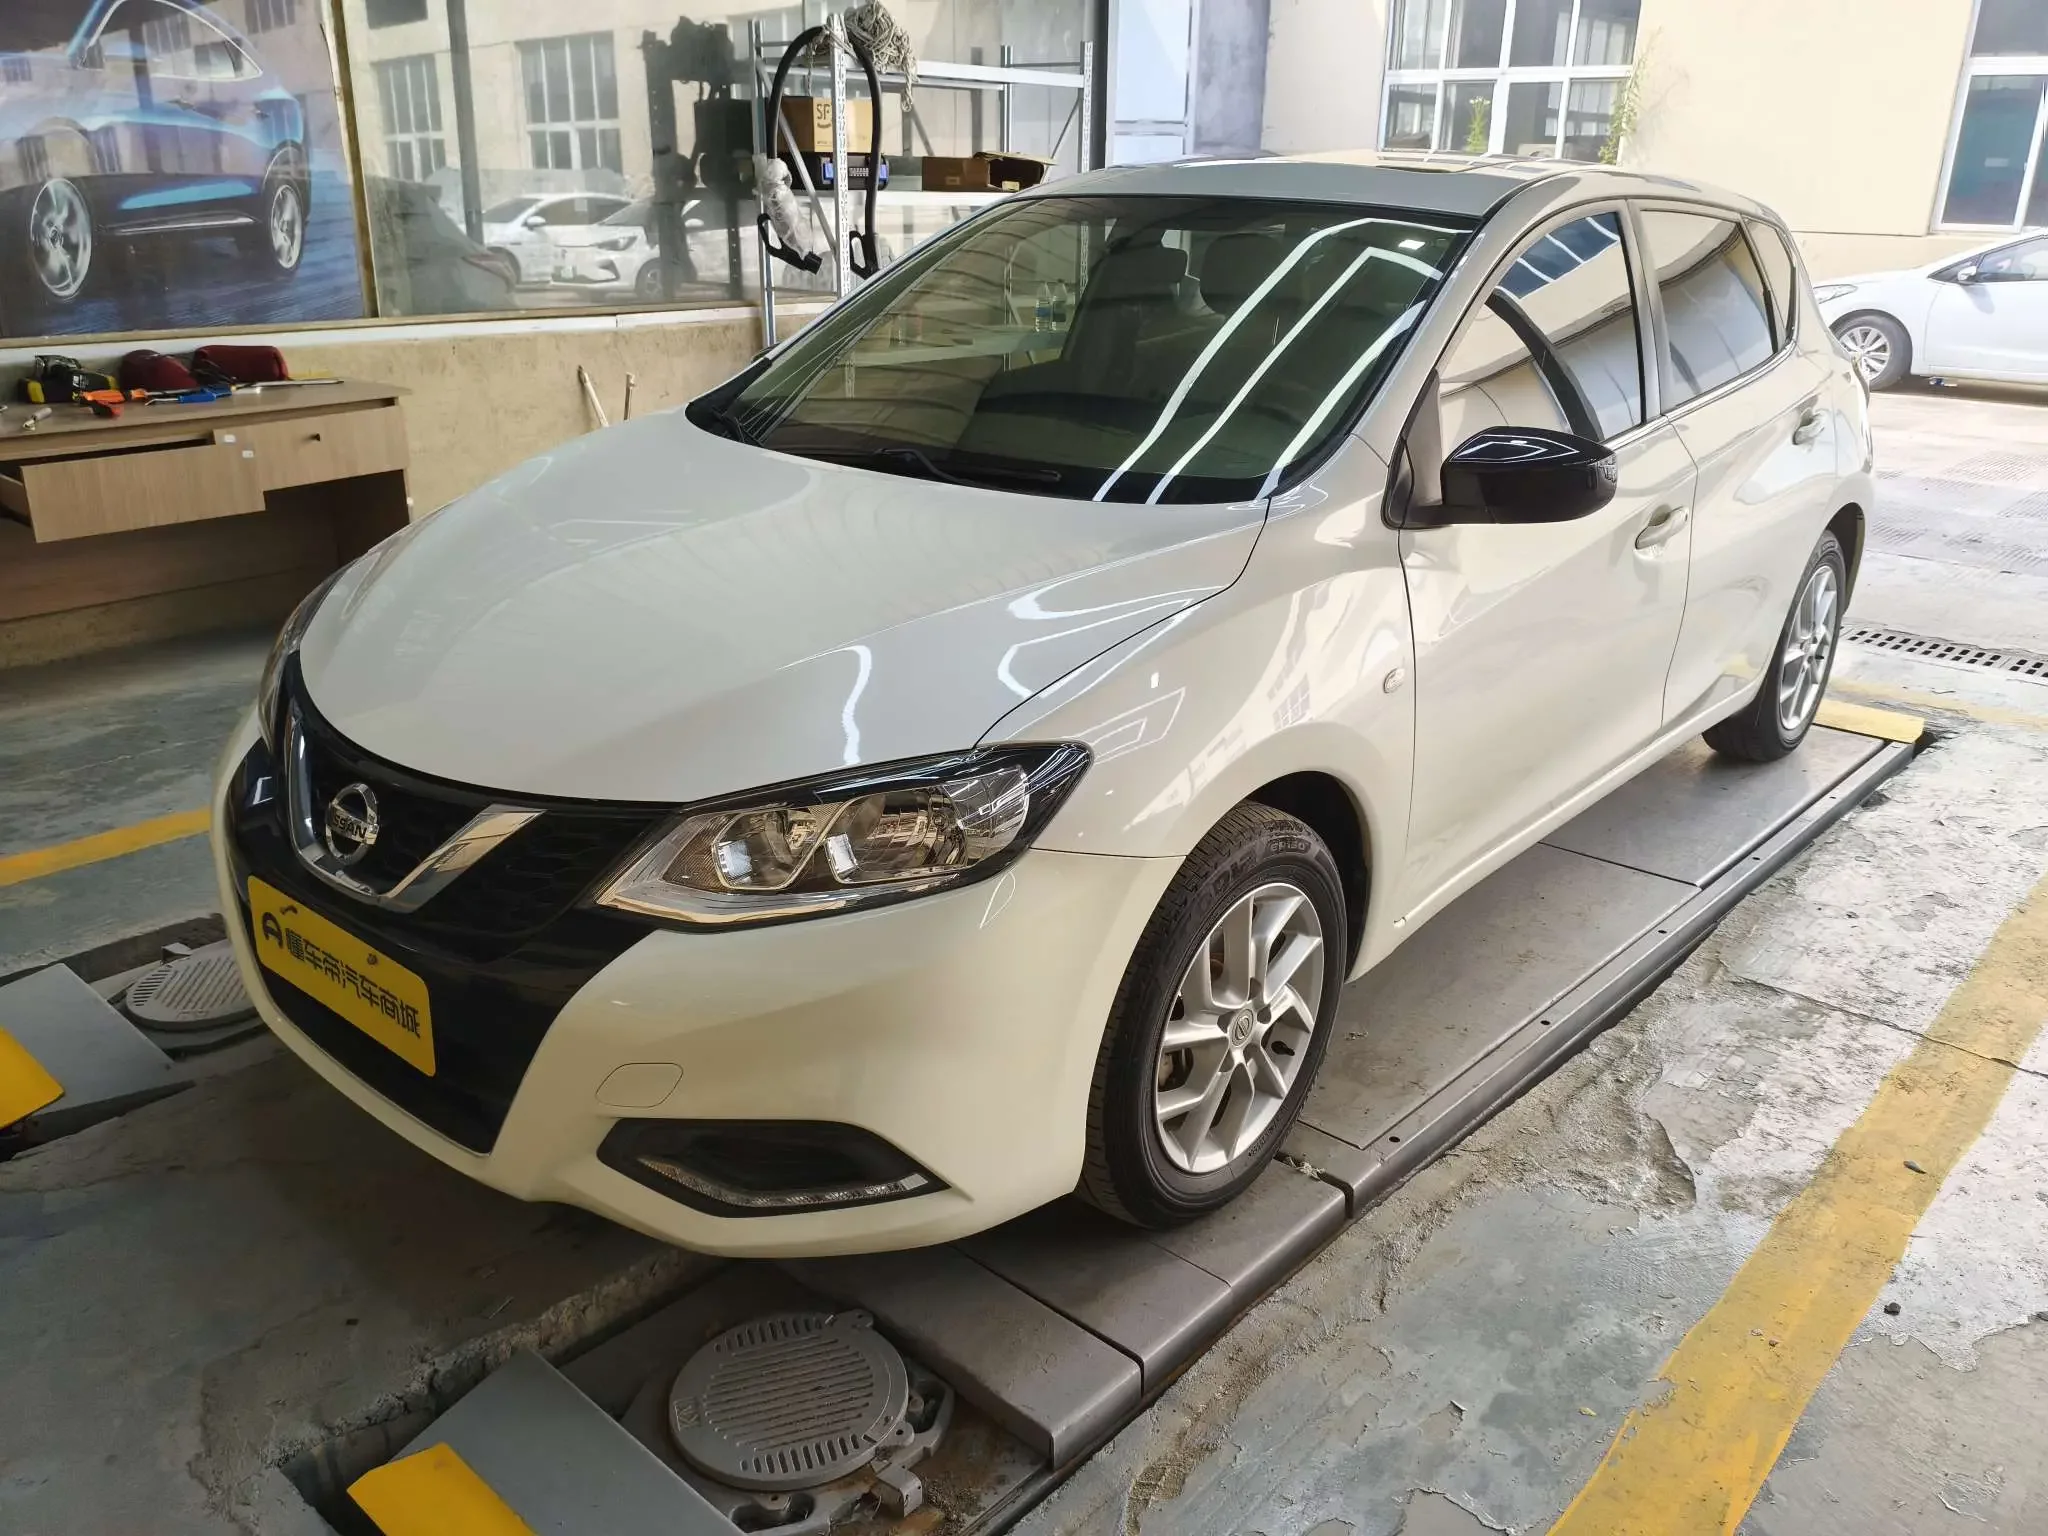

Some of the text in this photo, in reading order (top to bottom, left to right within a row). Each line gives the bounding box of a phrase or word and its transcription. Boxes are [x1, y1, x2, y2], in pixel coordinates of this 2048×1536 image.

[816, 103, 831, 120] SF
[286, 928, 420, 1038] 懂车帝汽车商城
